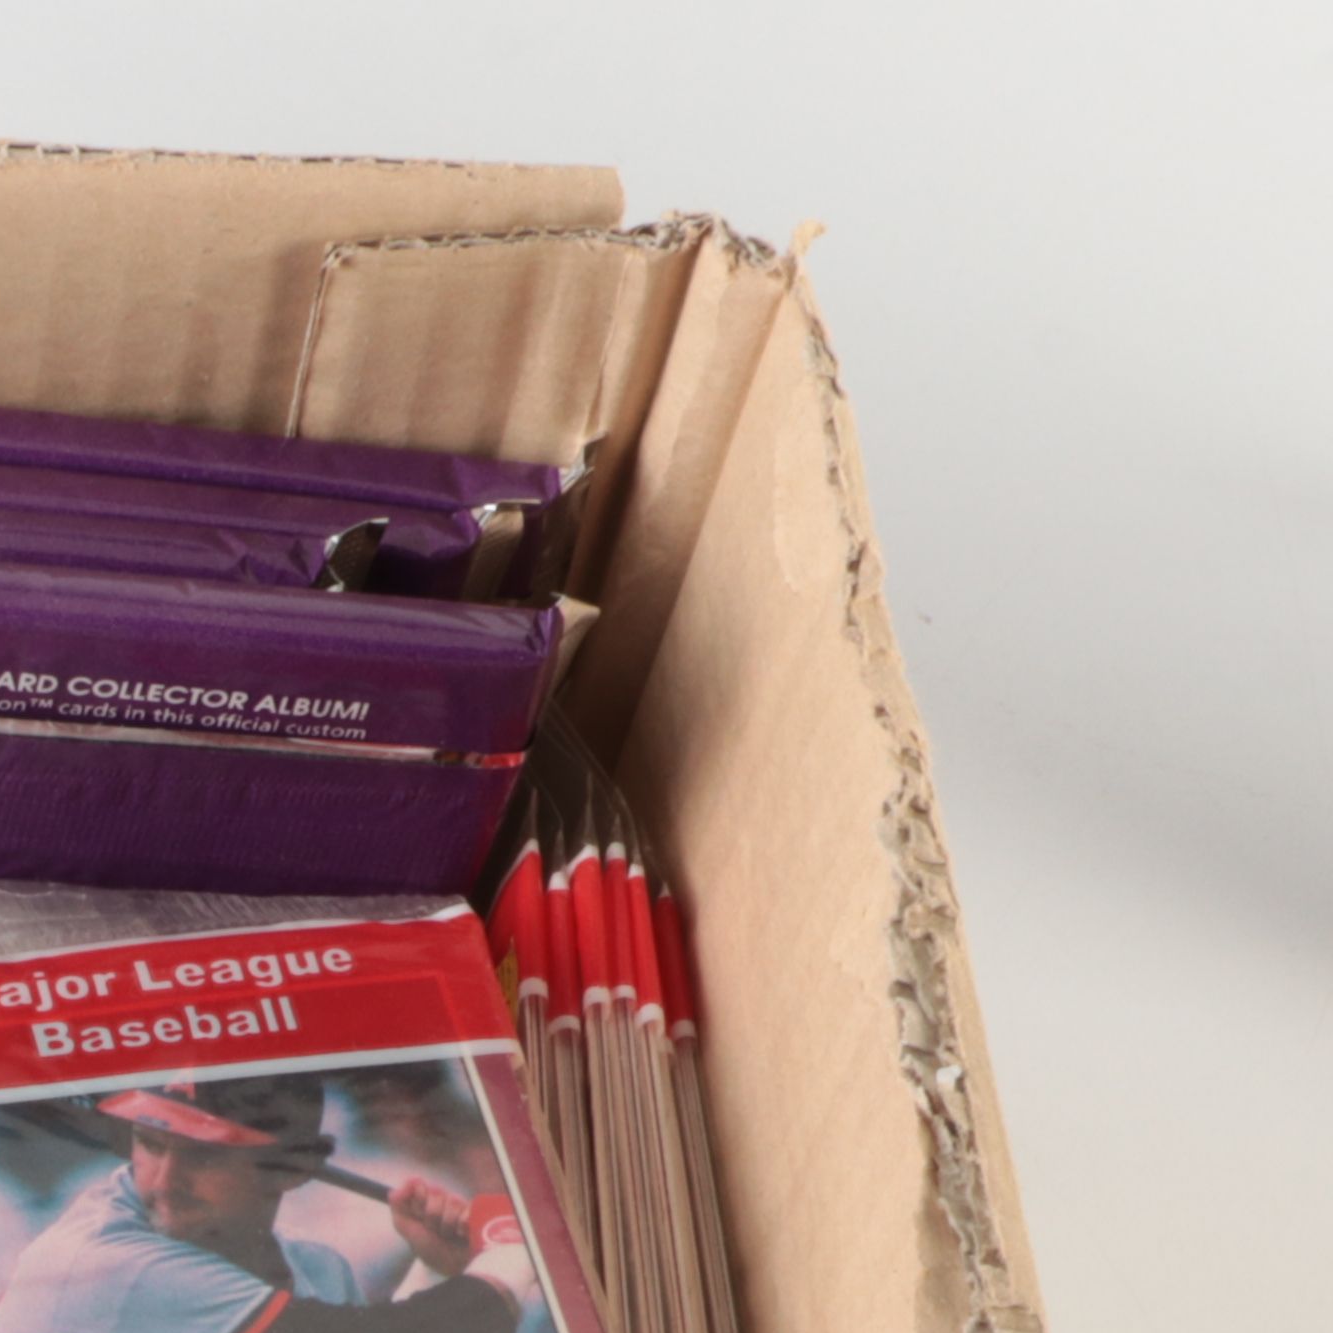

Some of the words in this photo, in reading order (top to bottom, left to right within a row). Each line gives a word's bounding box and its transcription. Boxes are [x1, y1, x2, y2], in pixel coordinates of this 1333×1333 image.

[58, 700, 117, 720] cards
[124, 704, 145, 721] in
[153, 708, 195, 726] this
[200, 712, 279, 734] official
[286, 721, 367, 741] custom
[66, 676, 250, 711] COLLECTOR
[254, 696, 371, 722] ALBUM!
[133, 943, 356, 995] League
[32, 997, 301, 1059] Baseball
